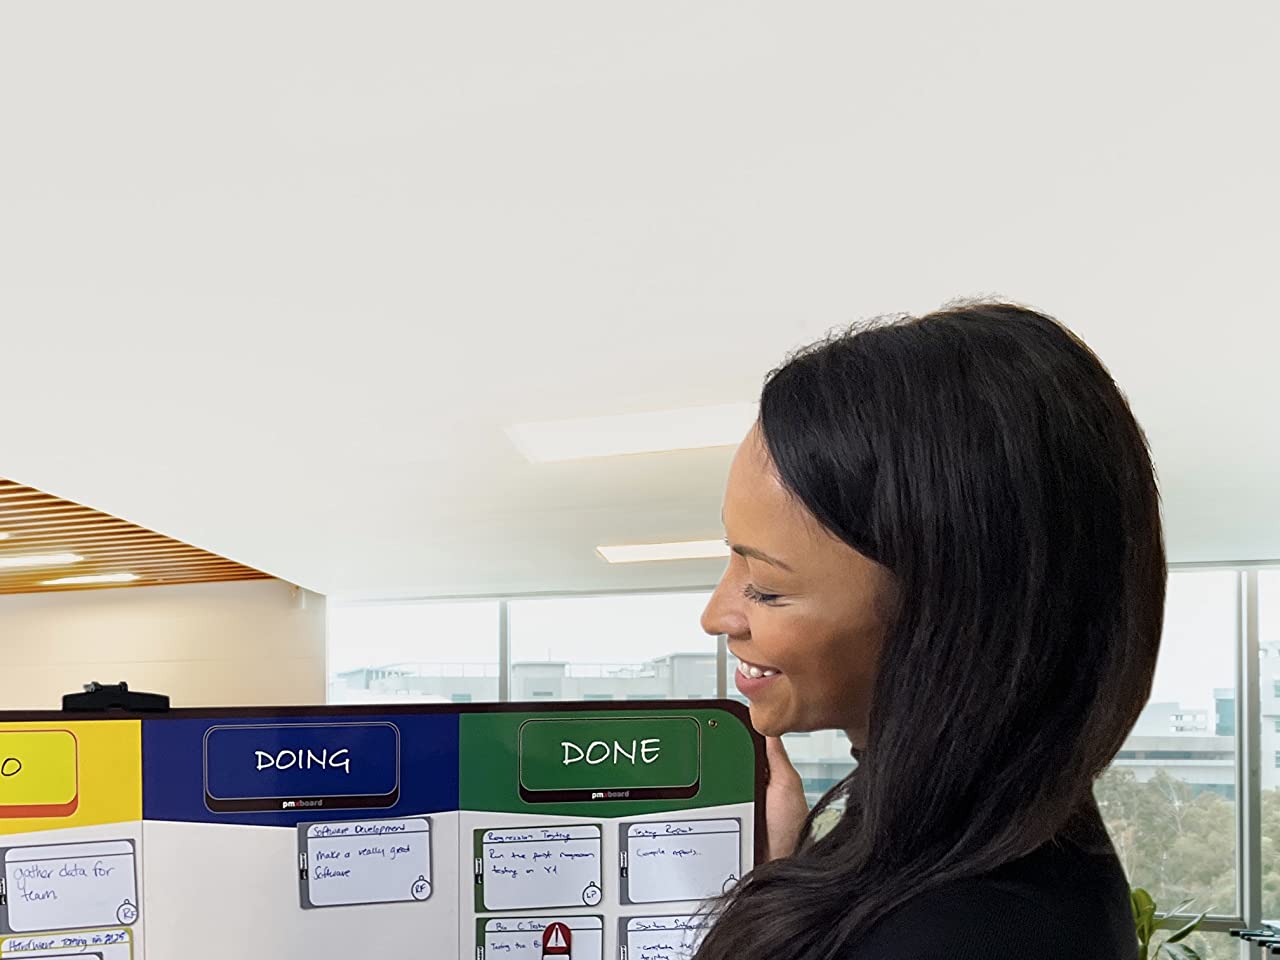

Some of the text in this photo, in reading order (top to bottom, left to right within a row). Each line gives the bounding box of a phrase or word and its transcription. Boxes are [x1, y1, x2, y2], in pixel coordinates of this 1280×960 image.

[254, 749, 351, 774] DOING
[561, 738, 661, 766] DONE
[13, 865, 54, 891] gather
[59, 863, 88, 877] data
[92, 861, 116, 877] for
[20, 888, 58, 902] team
